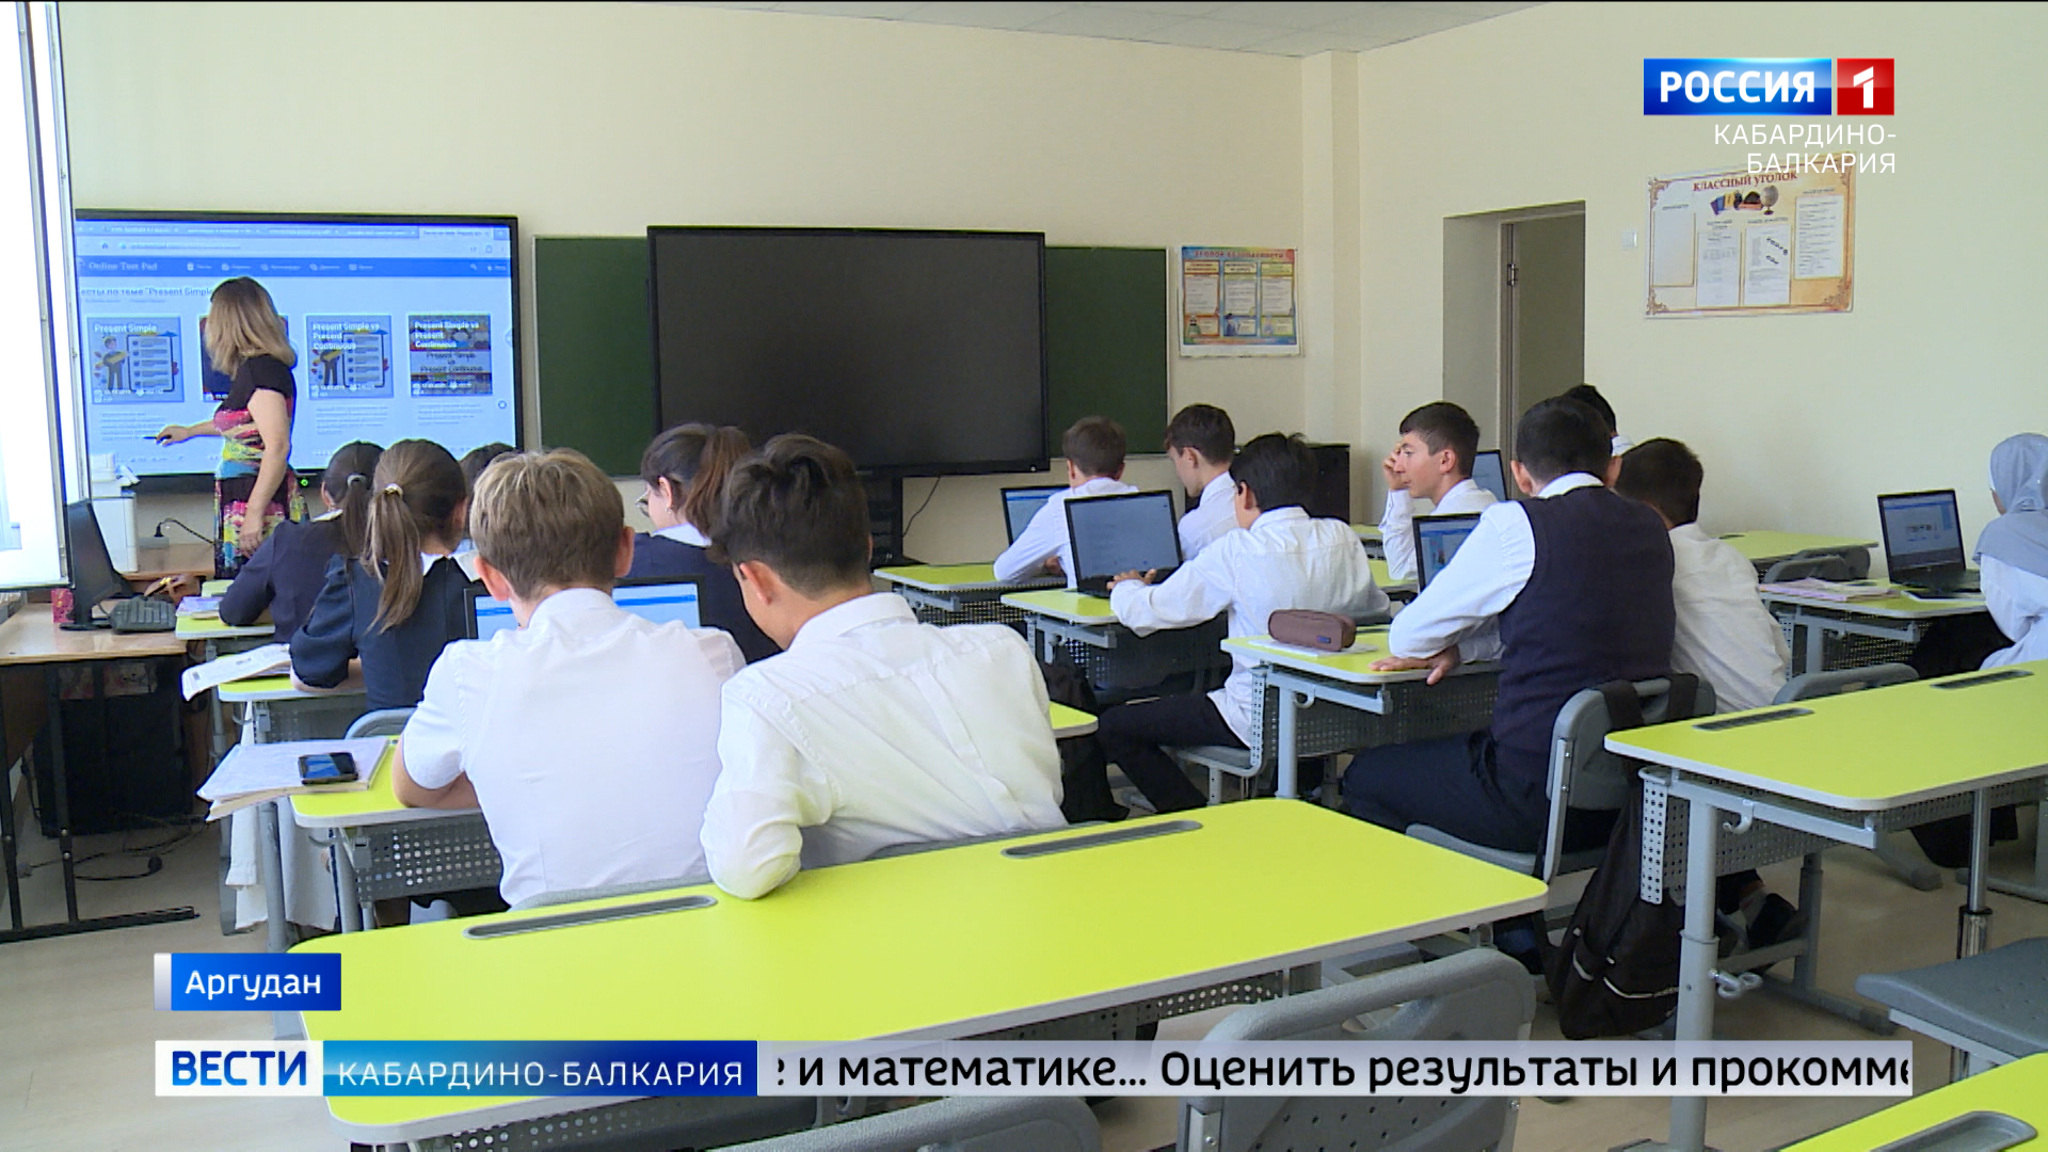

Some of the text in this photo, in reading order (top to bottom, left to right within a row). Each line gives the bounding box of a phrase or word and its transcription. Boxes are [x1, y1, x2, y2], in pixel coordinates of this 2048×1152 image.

[1693, 171, 1798, 191] КЛАССНЫЙ УГОЛОК
[88, 262, 158, 271] Online Test Pad
[94, 323, 157, 334] Present Simple
[343, 322, 370, 331] Simple
[444, 321, 470, 330] Simple
